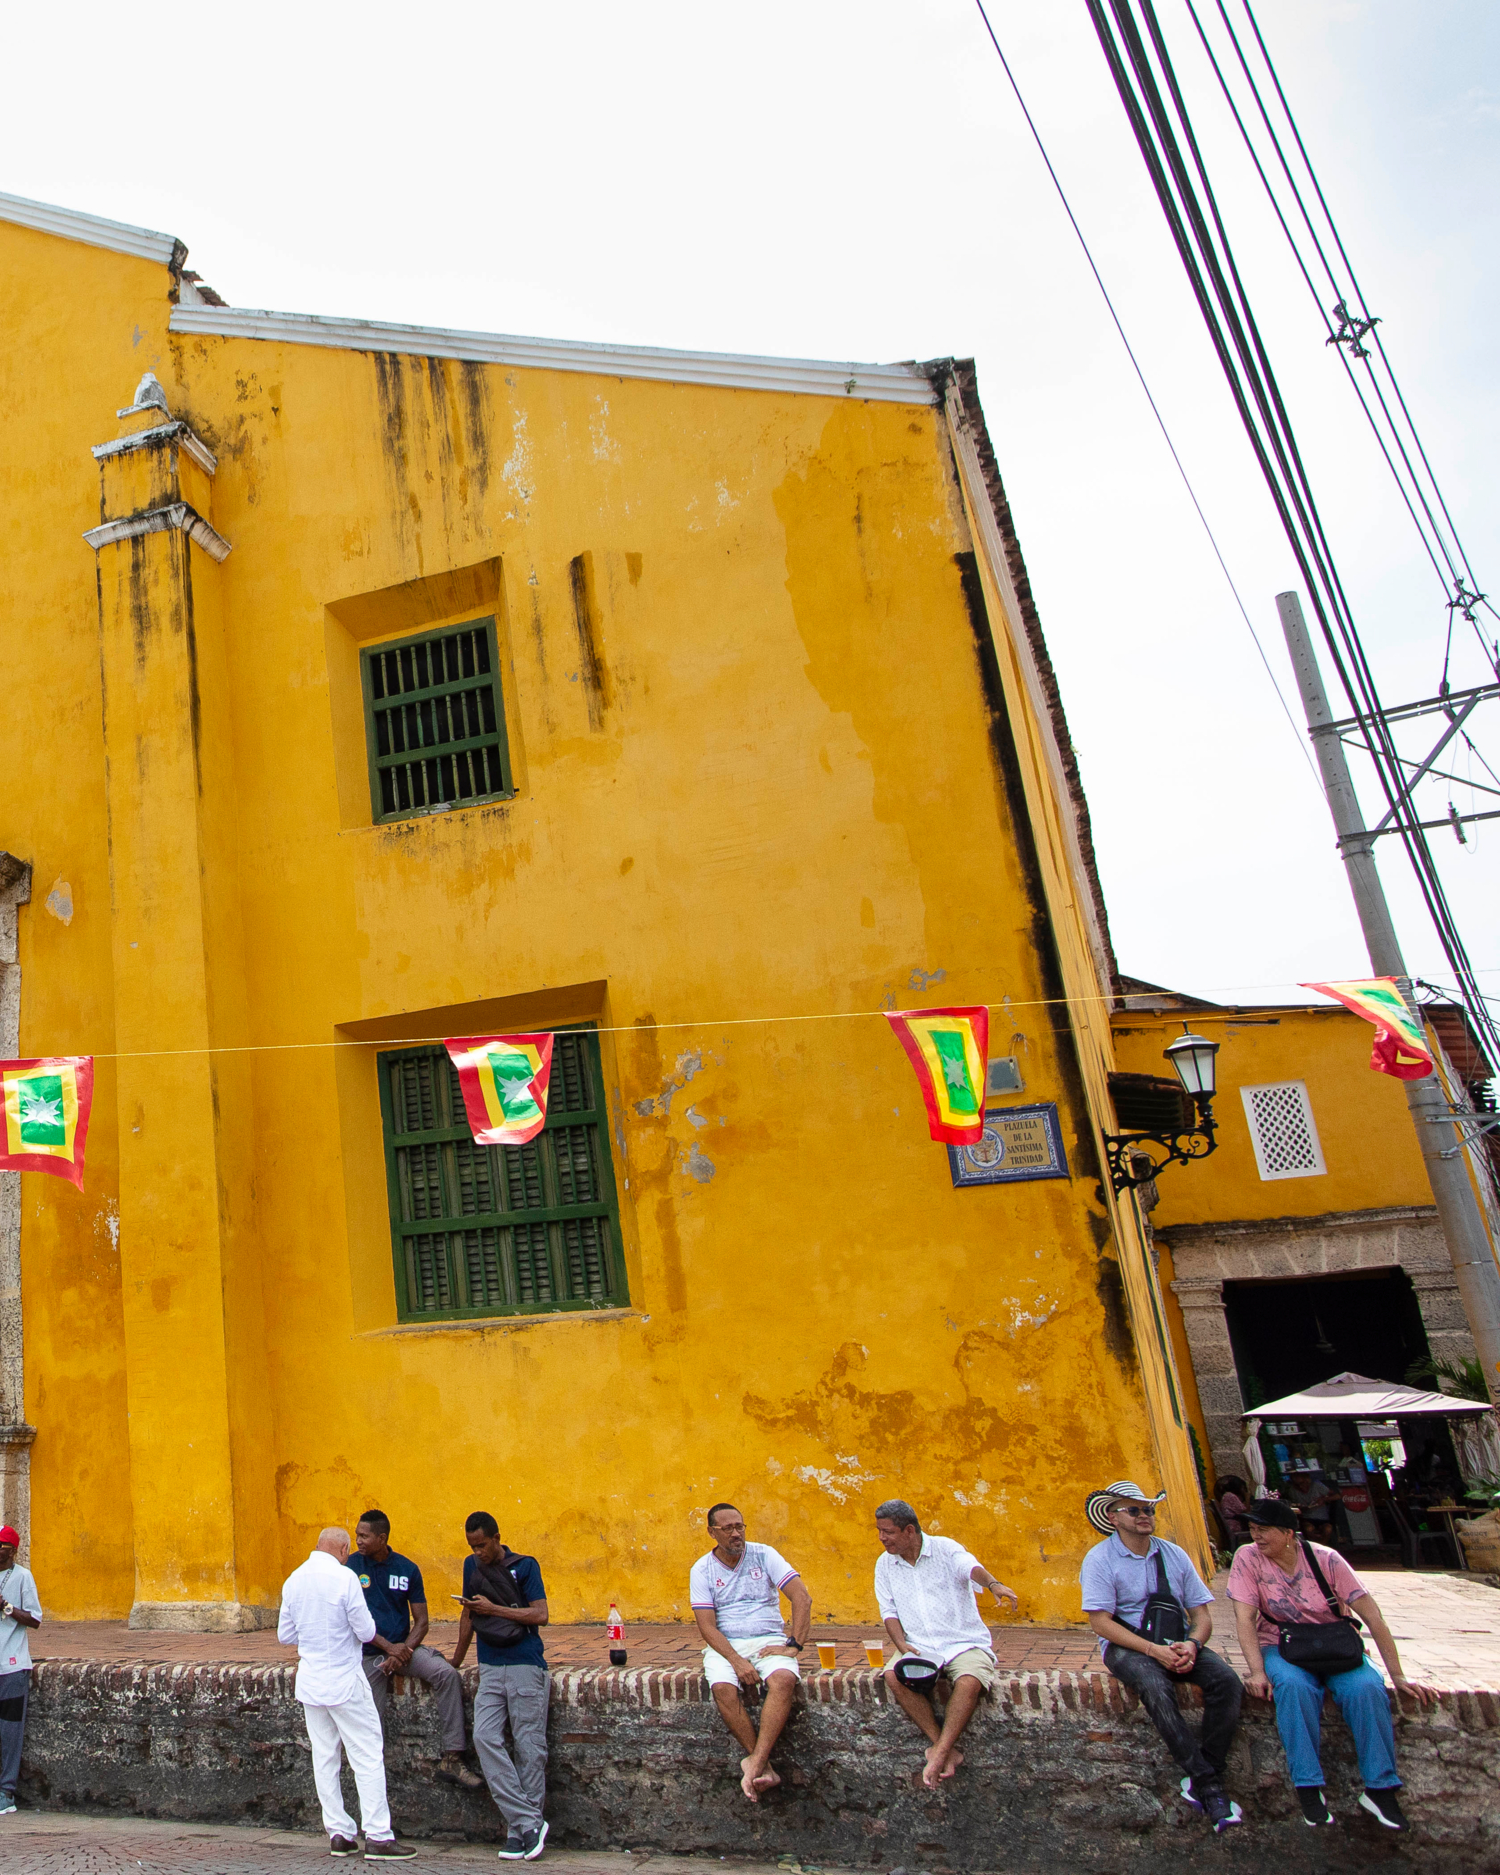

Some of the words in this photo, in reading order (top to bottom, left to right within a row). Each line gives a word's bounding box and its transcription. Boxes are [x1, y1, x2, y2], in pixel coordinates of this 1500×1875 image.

[1004, 1120, 1038, 1131] PLAZUELA
[1013, 1133, 1022, 1142] DE
[1023, 1132, 1033, 1141] LA
[1006, 1142, 1043, 1154] SANTÍSIMA
[1010, 1154, 1044, 1165] TRINIDAD
[388, 1574, 409, 1591] DS
